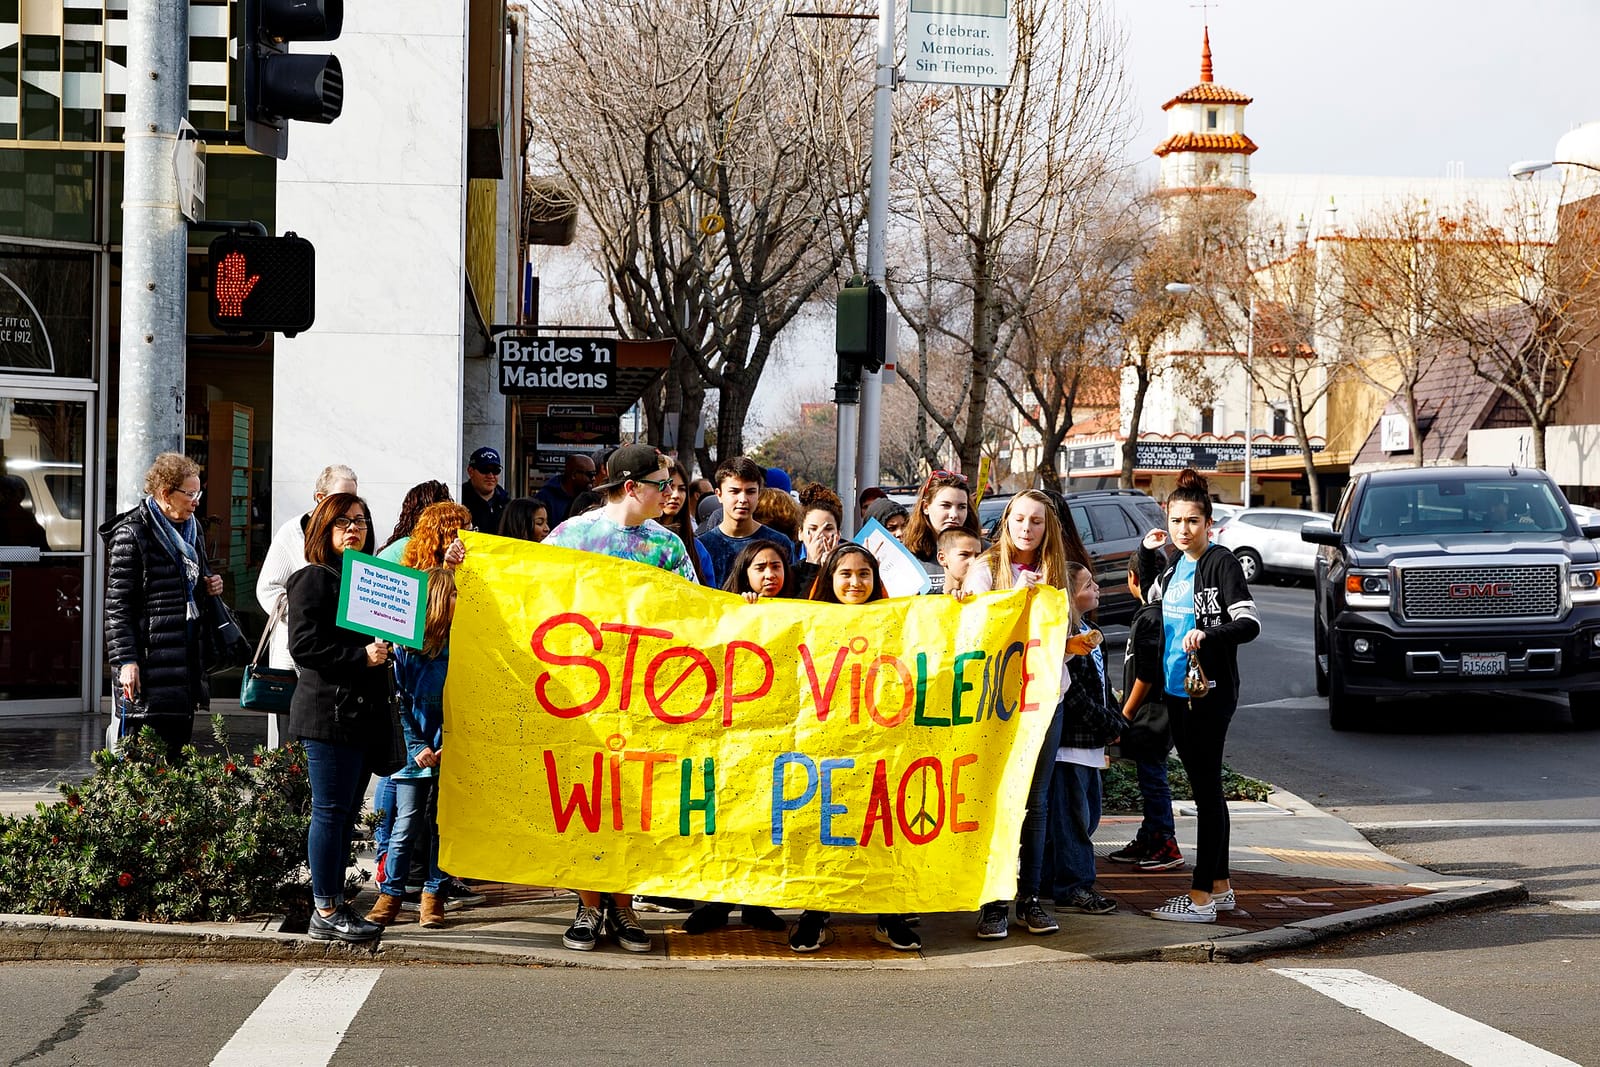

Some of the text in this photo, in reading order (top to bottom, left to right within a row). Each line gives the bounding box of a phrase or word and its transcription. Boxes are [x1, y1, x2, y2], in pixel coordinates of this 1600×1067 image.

[926, 23, 990, 39] Celebrar.
[920, 41, 995, 57] Memorias.
[915, 59, 998, 77] Sin Tiempo.
[5, 317, 18, 327] FIT
[14, 331, 32, 343] 1912
[502, 340, 583, 363] Brides
[502, 365, 608, 389] Maidens
[360, 576, 372, 585] find
[373, 581, 397, 592] yourself
[363, 568, 375, 577] The
[375, 571, 389, 581] best
[389, 576, 401, 585] way
[356, 584, 370, 593] lose
[370, 589, 395, 601] yourself
[401, 598, 411, 606] the
[1450, 583, 1514, 598] GMC
[359, 595, 380, 606] service
[387, 604, 408, 614] others.
[530, 612, 775, 728] STOP
[1463, 660, 1502, 672] 51566R1
